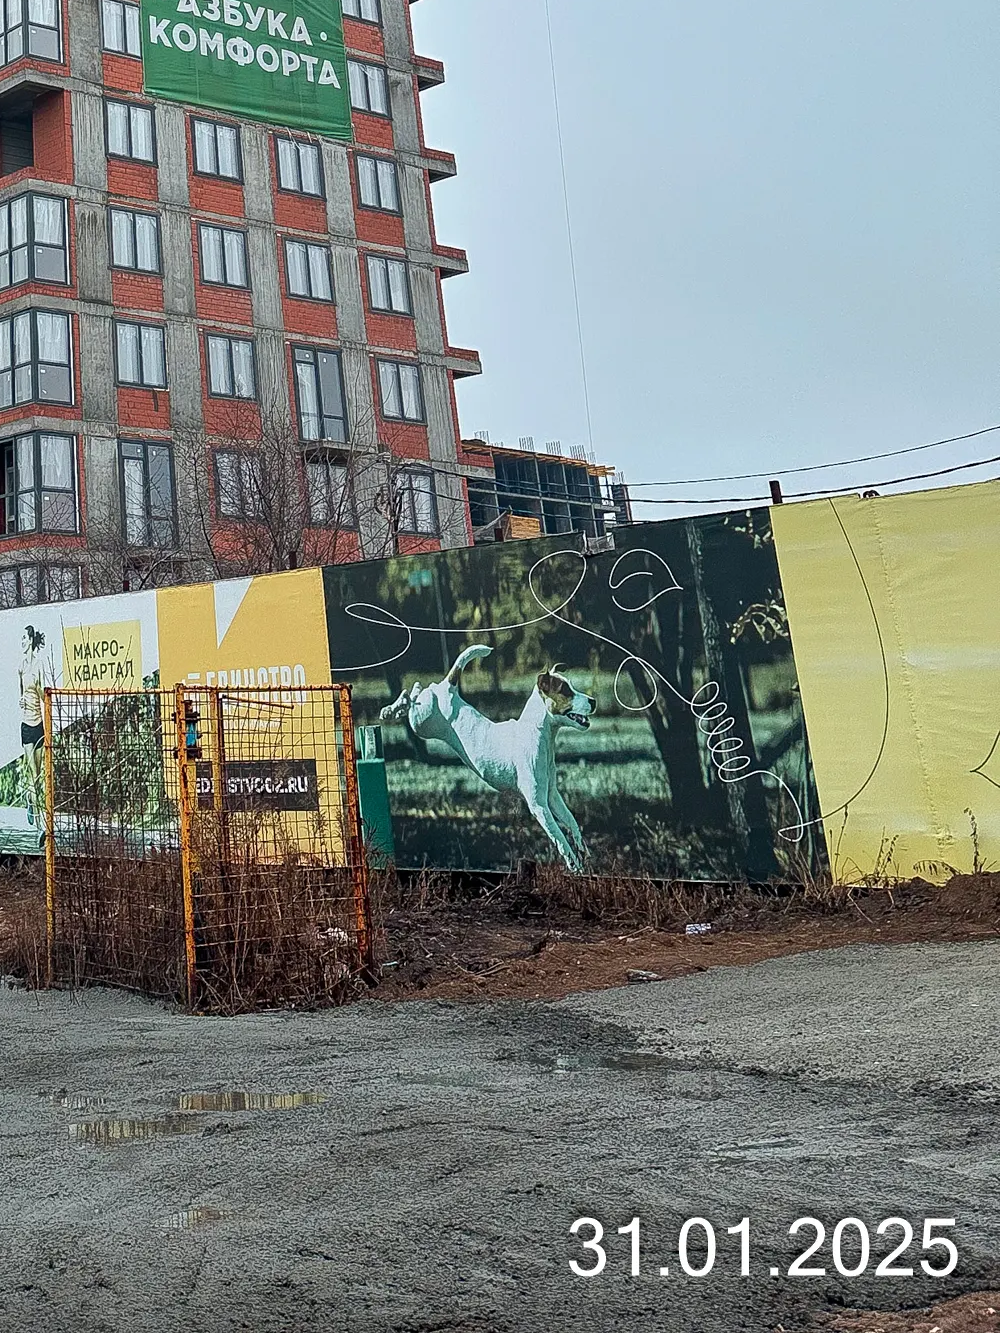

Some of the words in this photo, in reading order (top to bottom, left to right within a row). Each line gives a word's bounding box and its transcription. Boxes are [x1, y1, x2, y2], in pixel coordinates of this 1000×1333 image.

[149, 15, 341, 89] КОМФОРТА
[73, 639, 125, 661] МАКРО-
[74, 659, 134, 682] КВАРТАЛ
